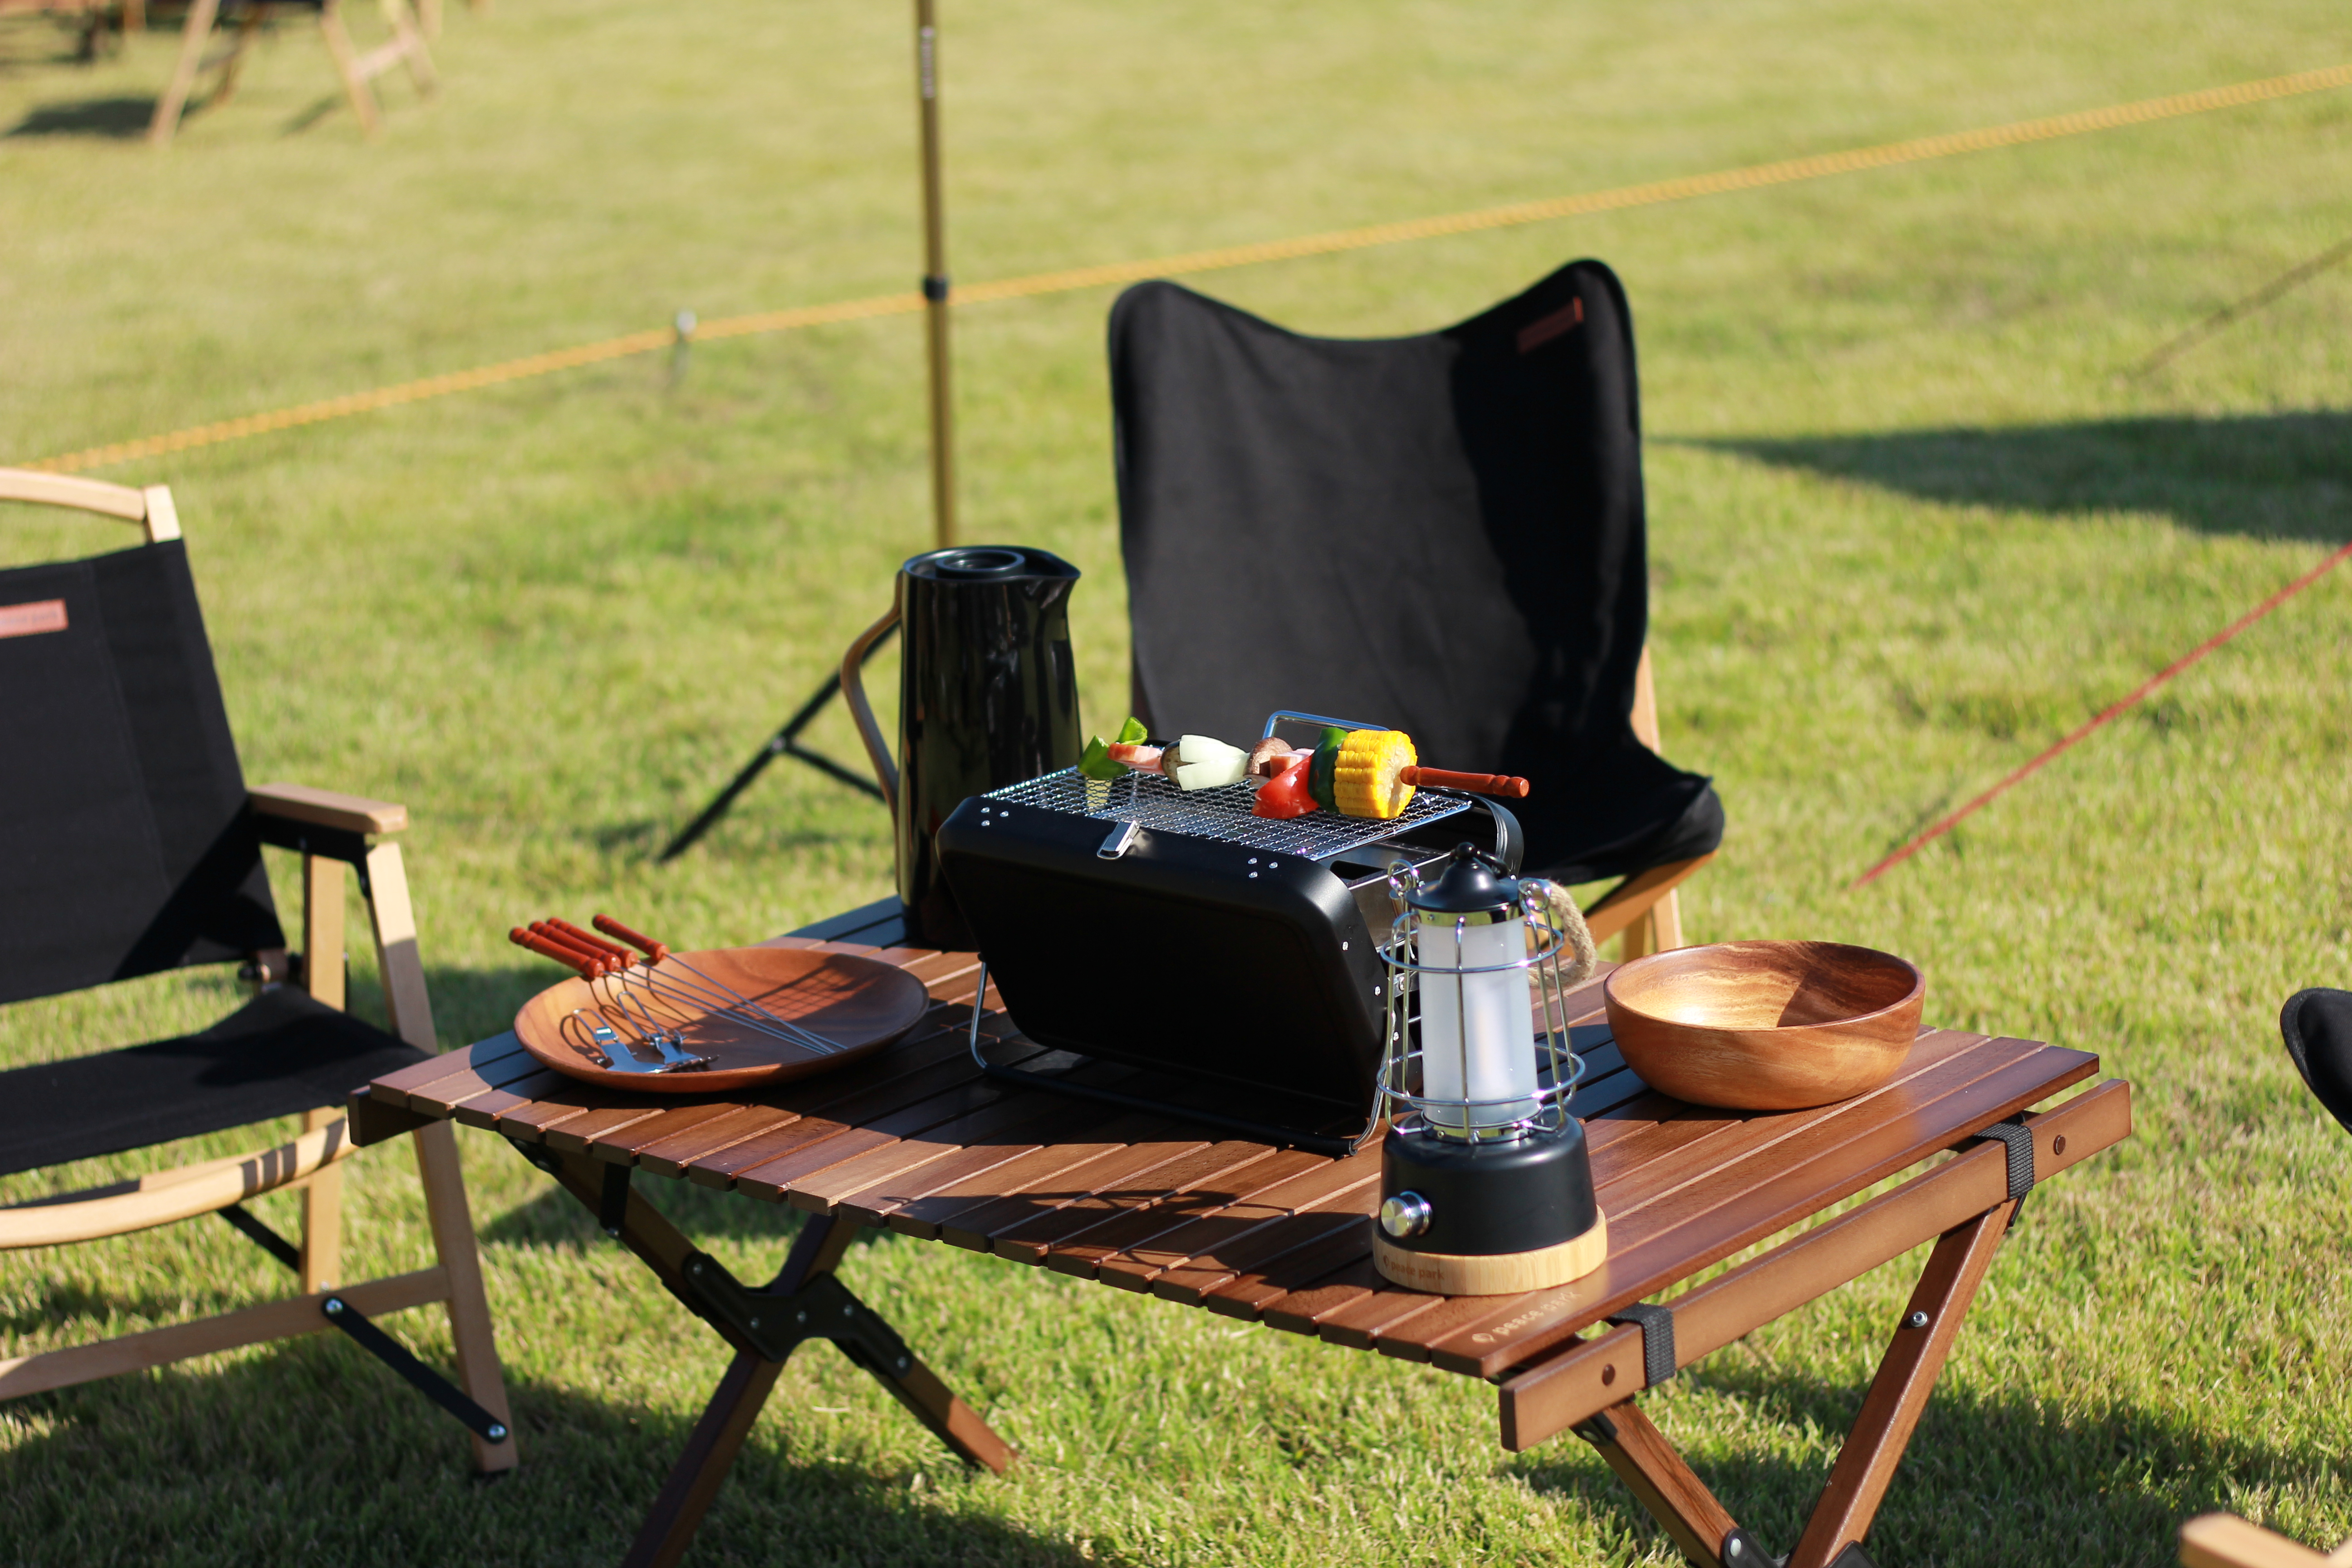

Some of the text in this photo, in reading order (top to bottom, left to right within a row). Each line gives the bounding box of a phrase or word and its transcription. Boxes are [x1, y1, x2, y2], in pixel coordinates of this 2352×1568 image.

[1391, 1261, 1445, 1280] peace park
[1492, 1292, 1583, 1336] peace park
